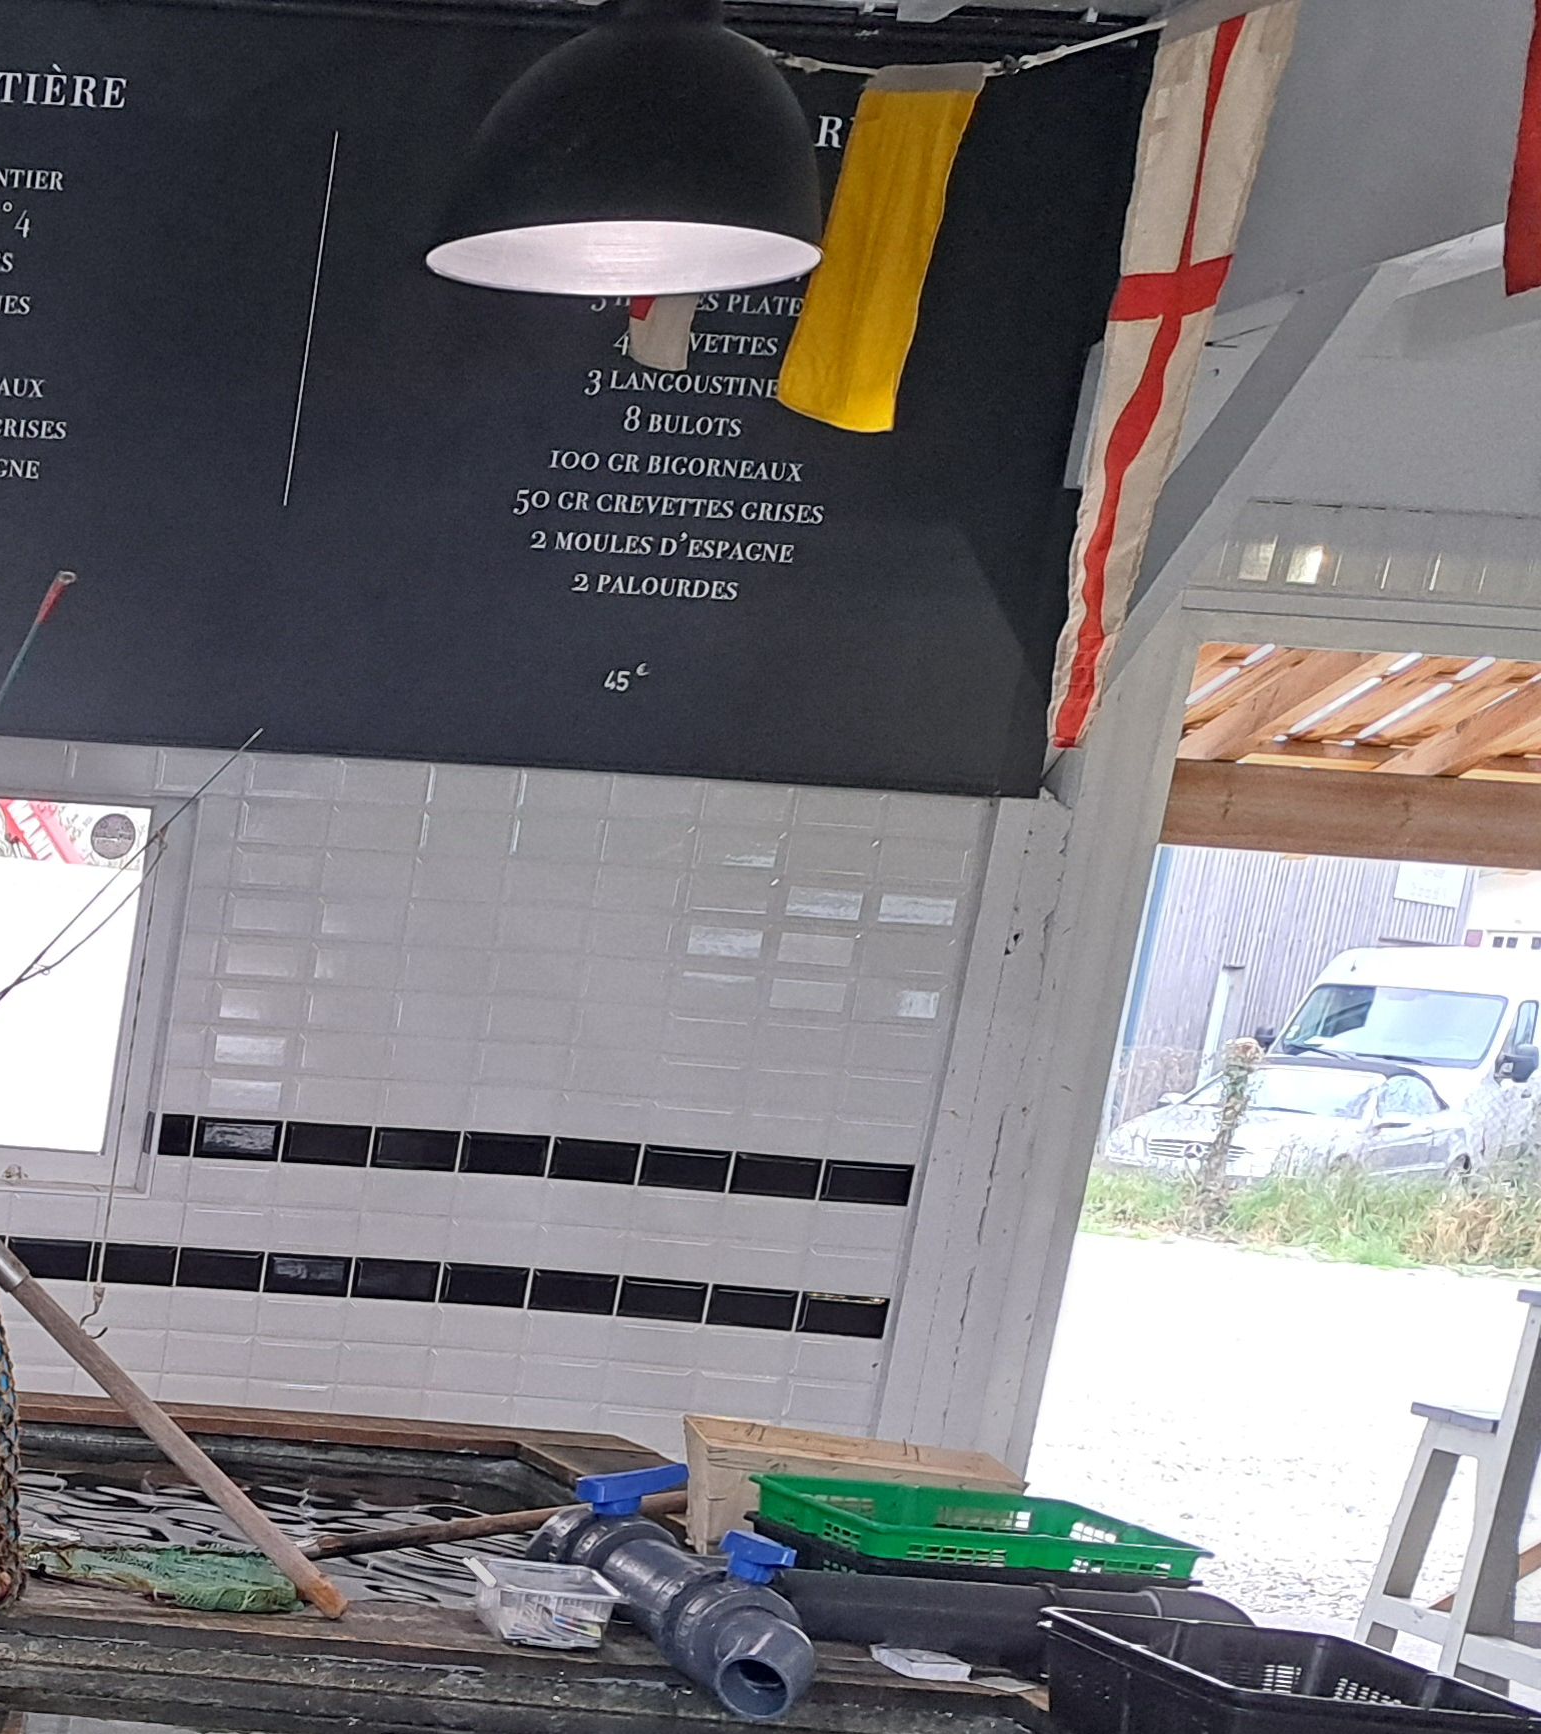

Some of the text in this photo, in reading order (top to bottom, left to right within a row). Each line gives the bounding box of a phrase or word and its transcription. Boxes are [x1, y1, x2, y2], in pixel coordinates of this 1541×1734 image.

[726, 294, 803, 318] PLATE
[613, 330, 779, 356] 4 VETTES
[583, 369, 778, 399] 3 LANGOUSTINE
[623, 405, 742, 438] 8 BULOTS
[549, 449, 804, 482] 100 GR BIGORNEAUX
[512, 489, 825, 525] 50 GR CREVETTES GRISES
[530, 530, 795, 564] 2 MOULES D'ESPAGNE
[571, 573, 739, 601] 2 PALOURDES
